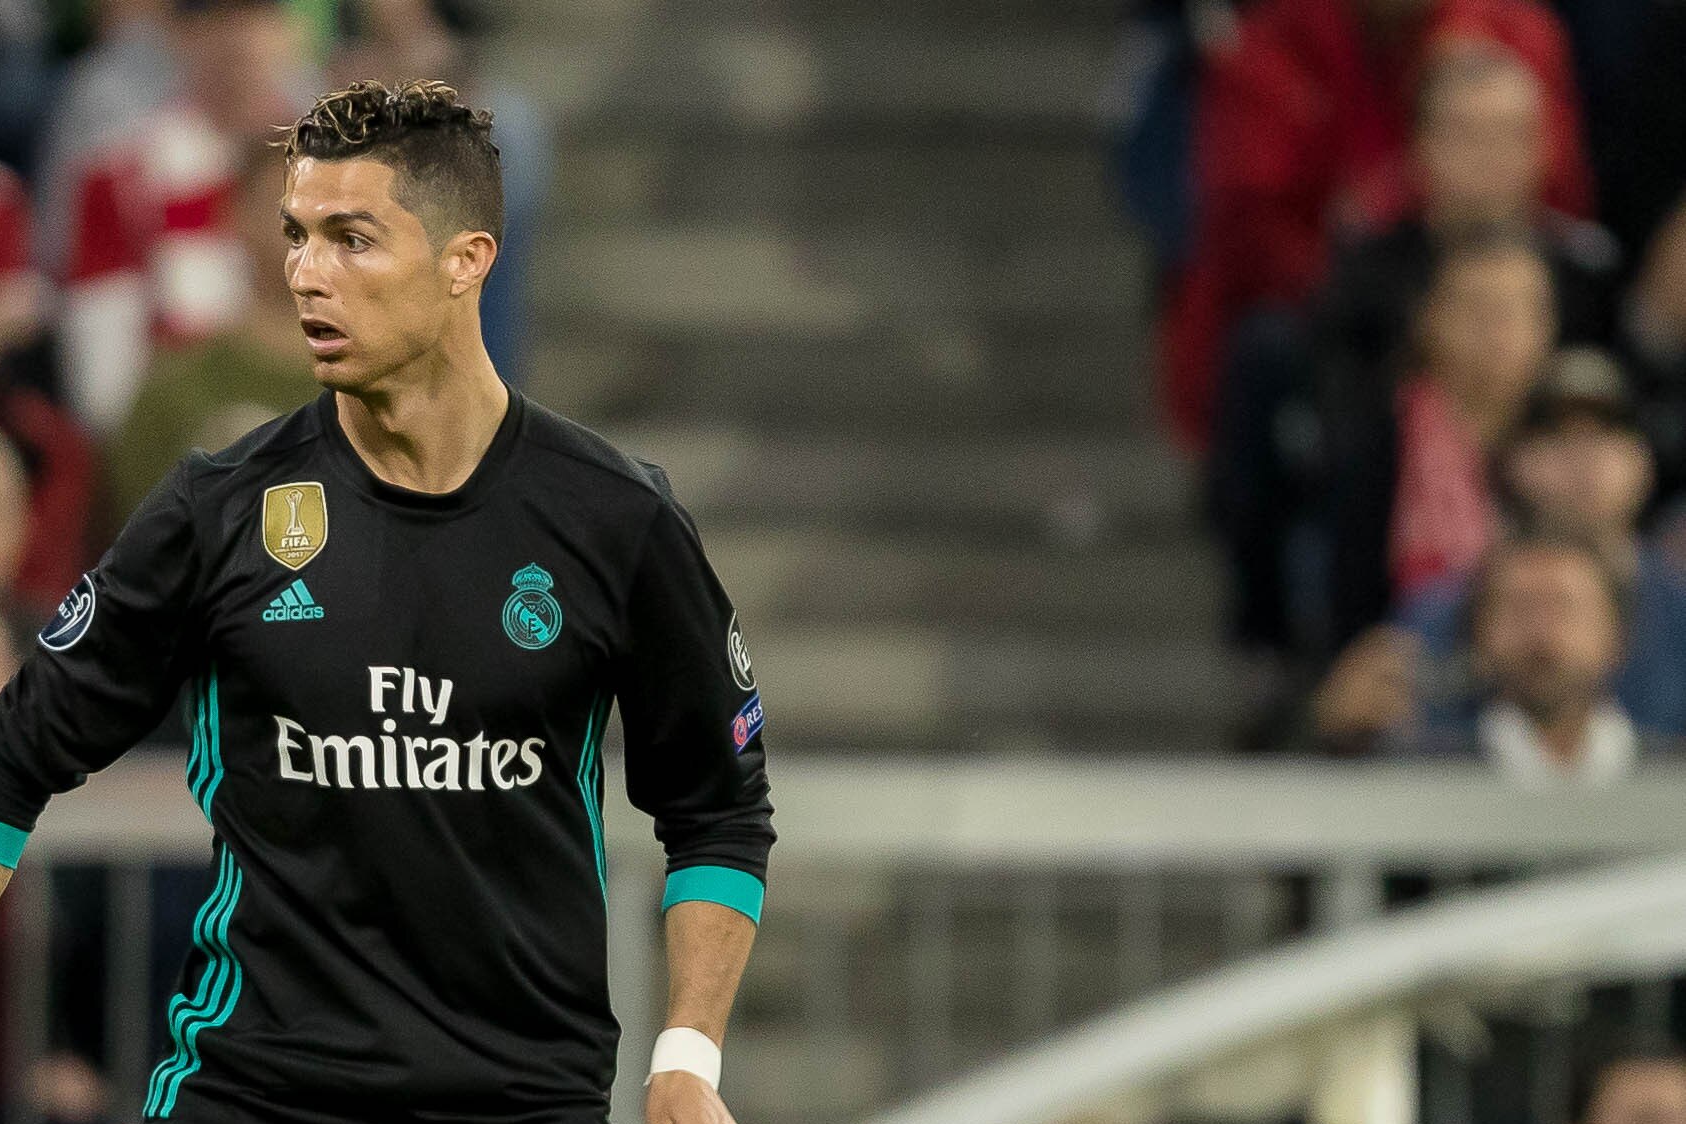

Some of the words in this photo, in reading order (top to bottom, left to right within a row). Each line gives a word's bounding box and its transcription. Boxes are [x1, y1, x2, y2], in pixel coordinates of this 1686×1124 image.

[281, 536, 310, 548] FIFA
[262, 605, 325, 622] adidas
[368, 667, 453, 725] Fly
[273, 715, 546, 791] Emirates
